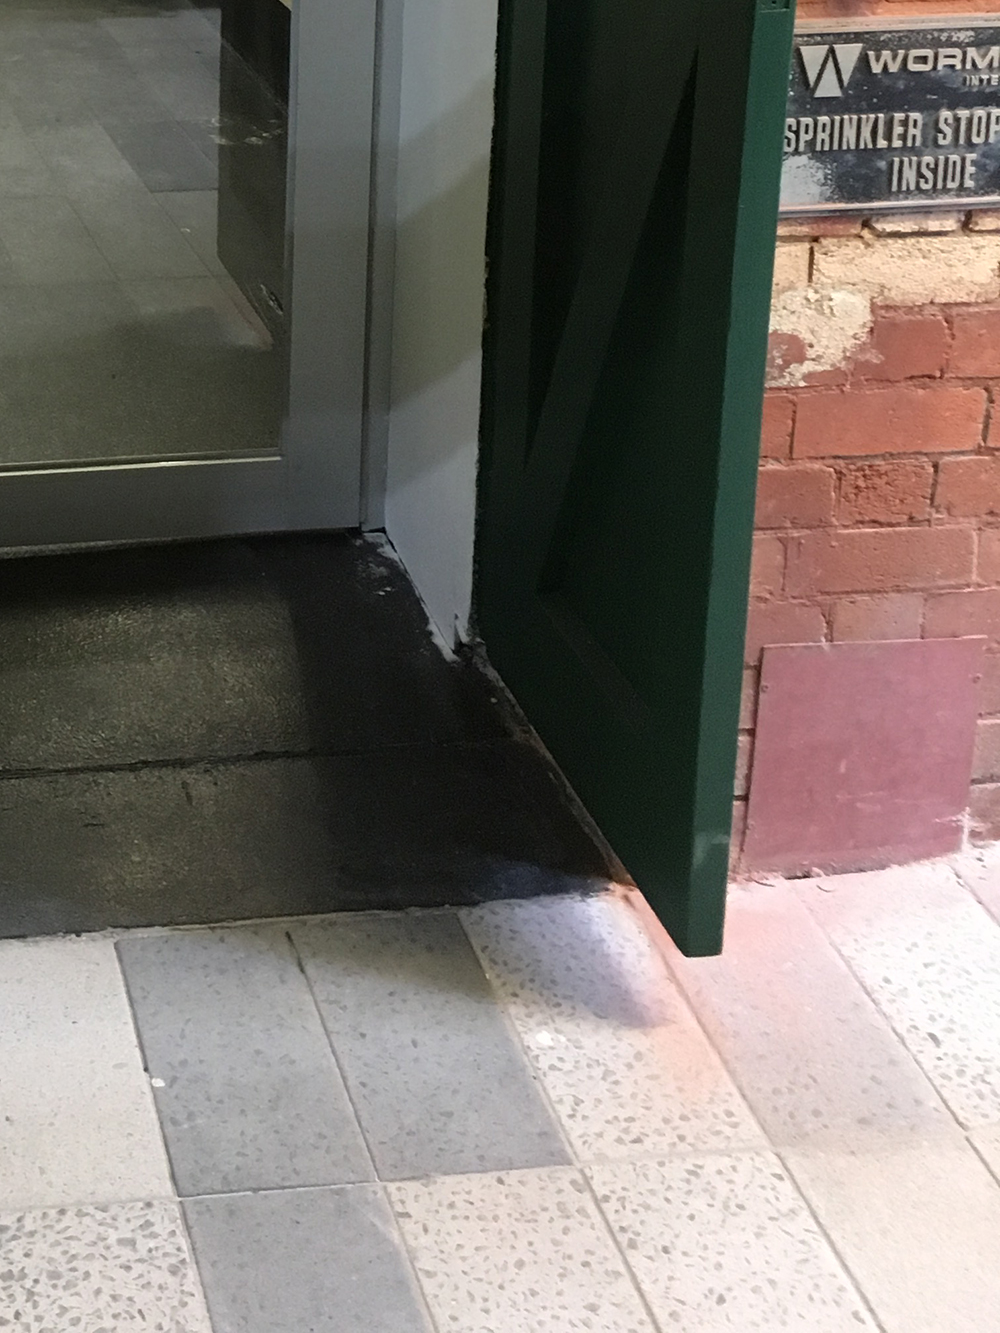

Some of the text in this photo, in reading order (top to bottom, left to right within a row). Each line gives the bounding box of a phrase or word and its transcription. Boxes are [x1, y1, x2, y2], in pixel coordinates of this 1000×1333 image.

[867, 46, 1000, 74] WORM
[966, 74, 999, 86] INTE
[784, 108, 1000, 153] SPRINKLER STOP
[891, 153, 977, 192] INSIDE
